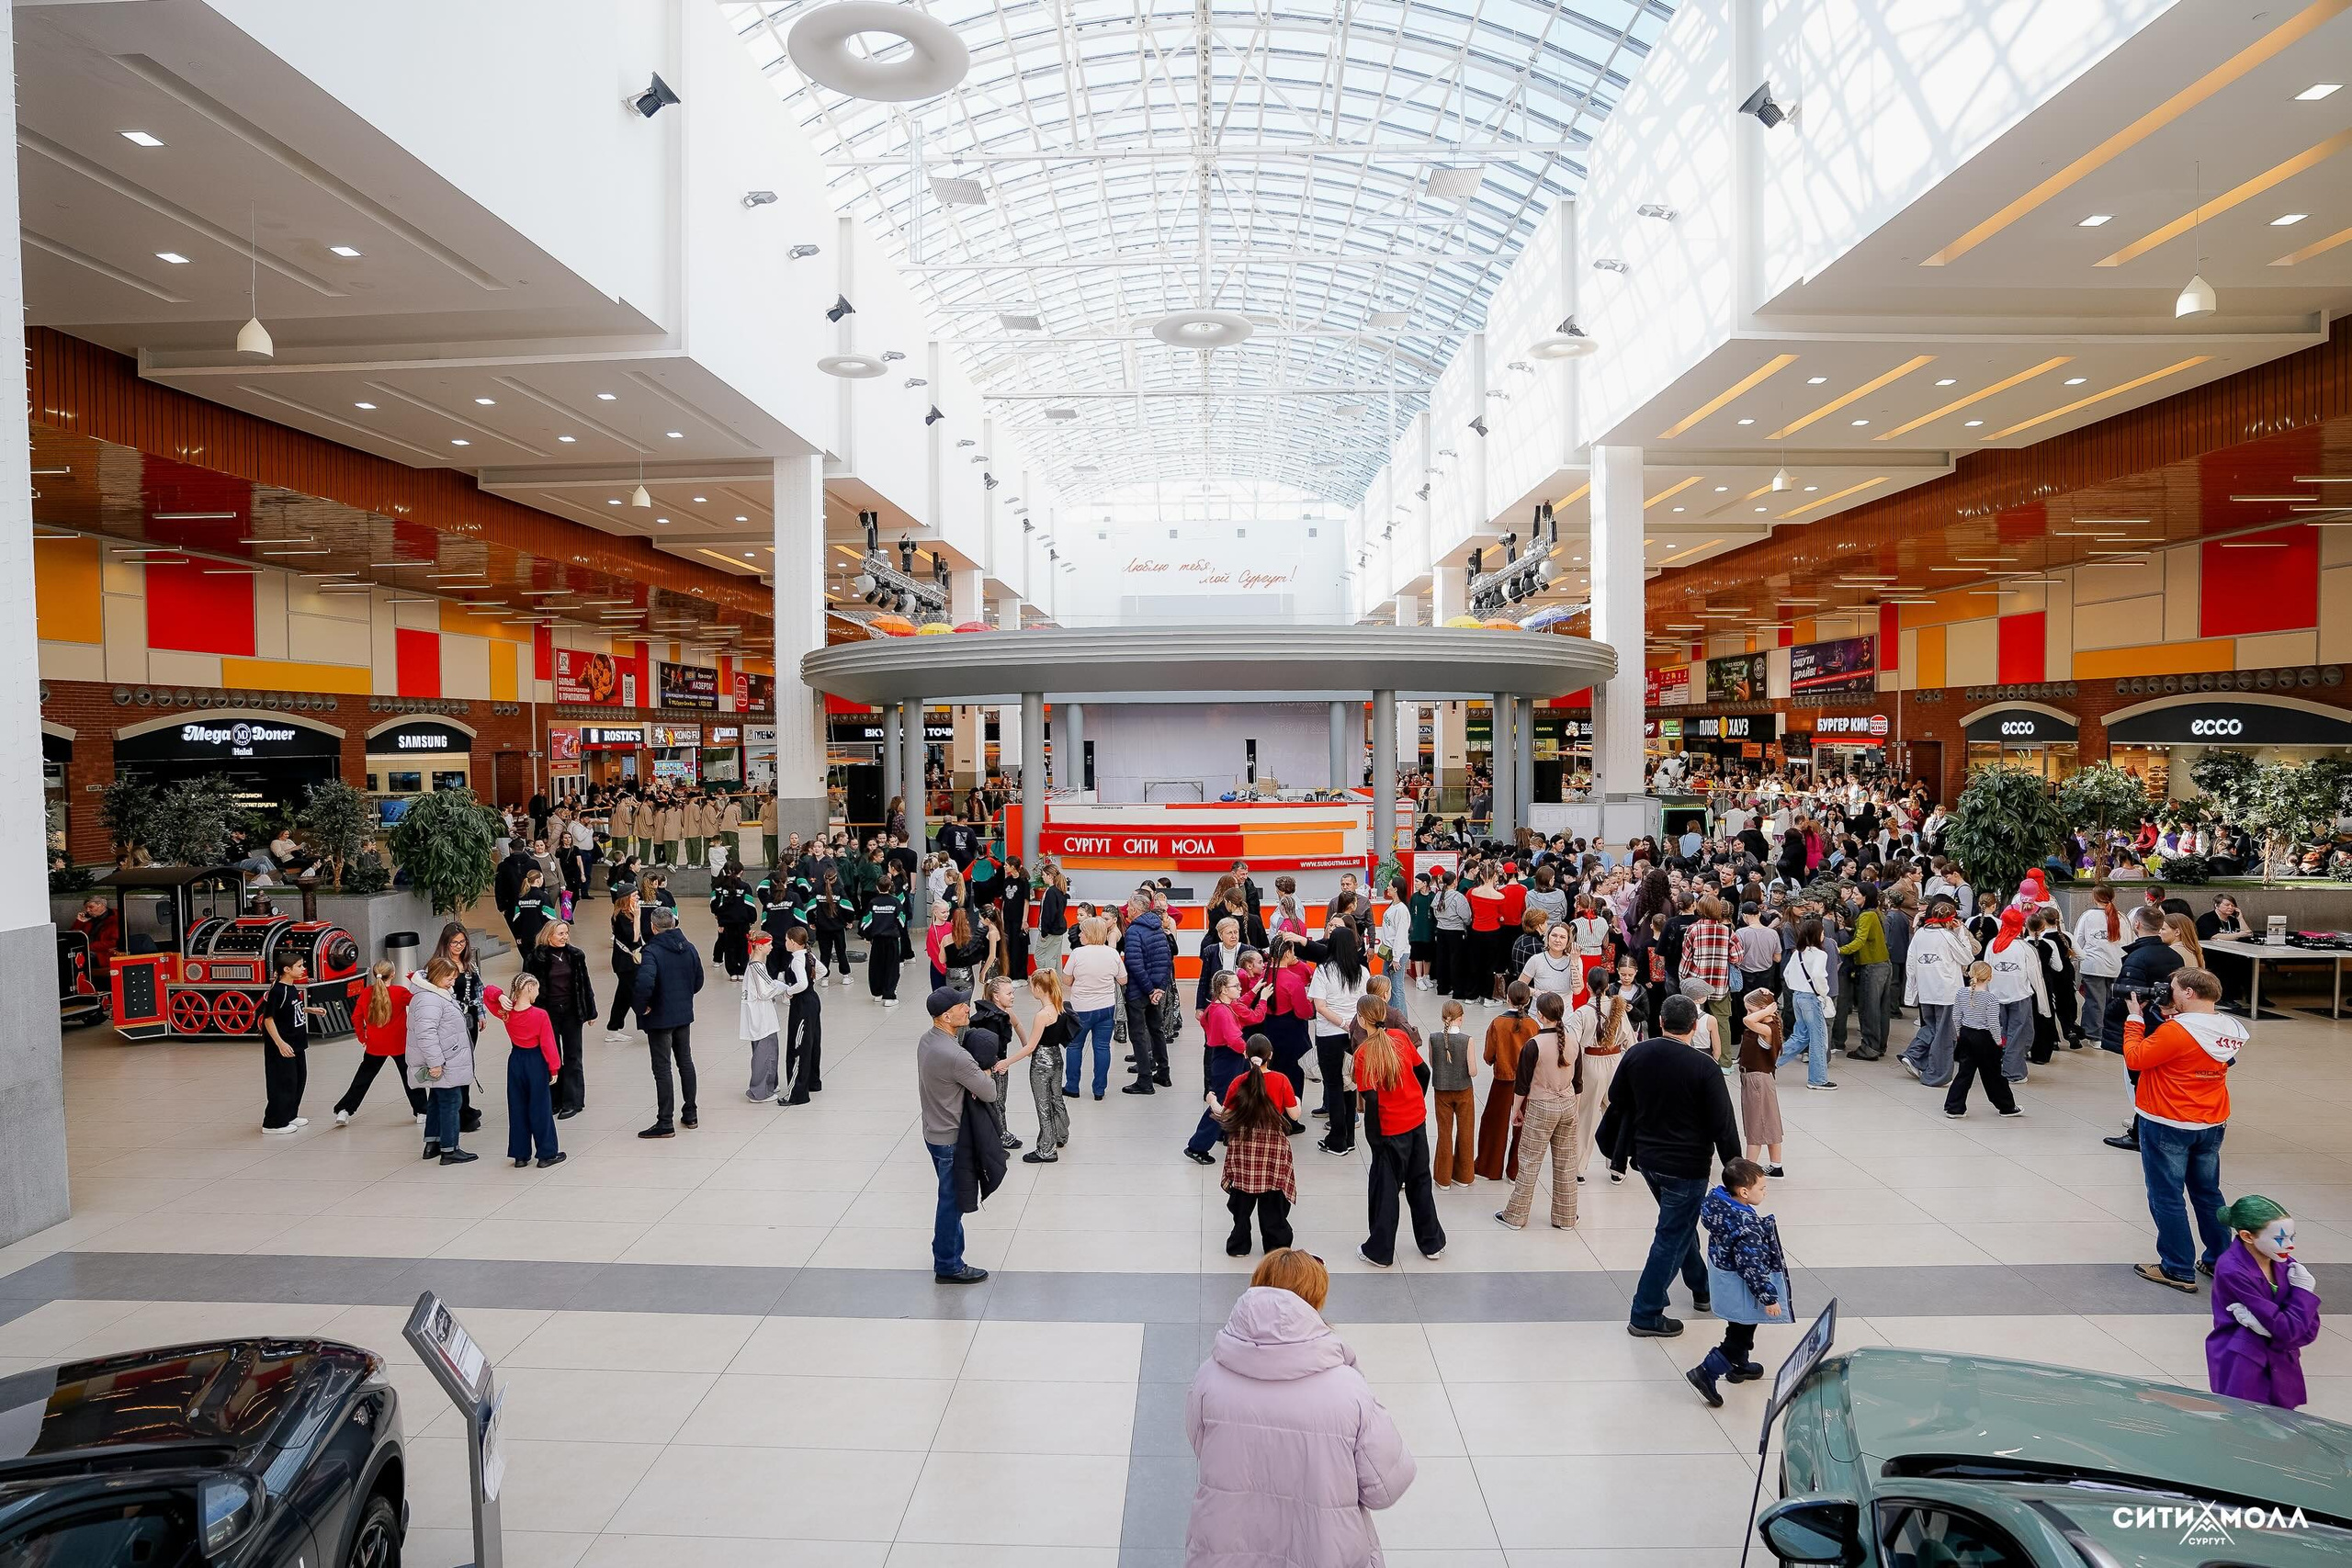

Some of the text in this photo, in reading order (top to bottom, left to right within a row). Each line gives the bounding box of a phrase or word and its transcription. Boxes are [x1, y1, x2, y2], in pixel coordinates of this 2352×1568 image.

[1123, 558, 1216, 572] Люблю тебя,
[1199, 565, 1297, 589] мой Сургут!
[1792, 655, 1815, 668] ОЩУТИ
[1699, 718, 1749, 736] ПЛОВ ХАУЗ
[1817, 717, 1870, 732] БУРГЕР КИН
[2002, 721, 2034, 735] ecco
[2191, 718, 2242, 735] ecco
[183, 725, 295, 744] Mega Doner
[604, 730, 641, 741] ROSTIC'S
[399, 735, 447, 749] SAMSUNG
[232, 747, 253, 755] Halal
[1064, 837, 1216, 854] СУРГУТ СИТИ МОЛЛ
[1300, 859, 1361, 868] WWW.SURGUTMALL.RU
